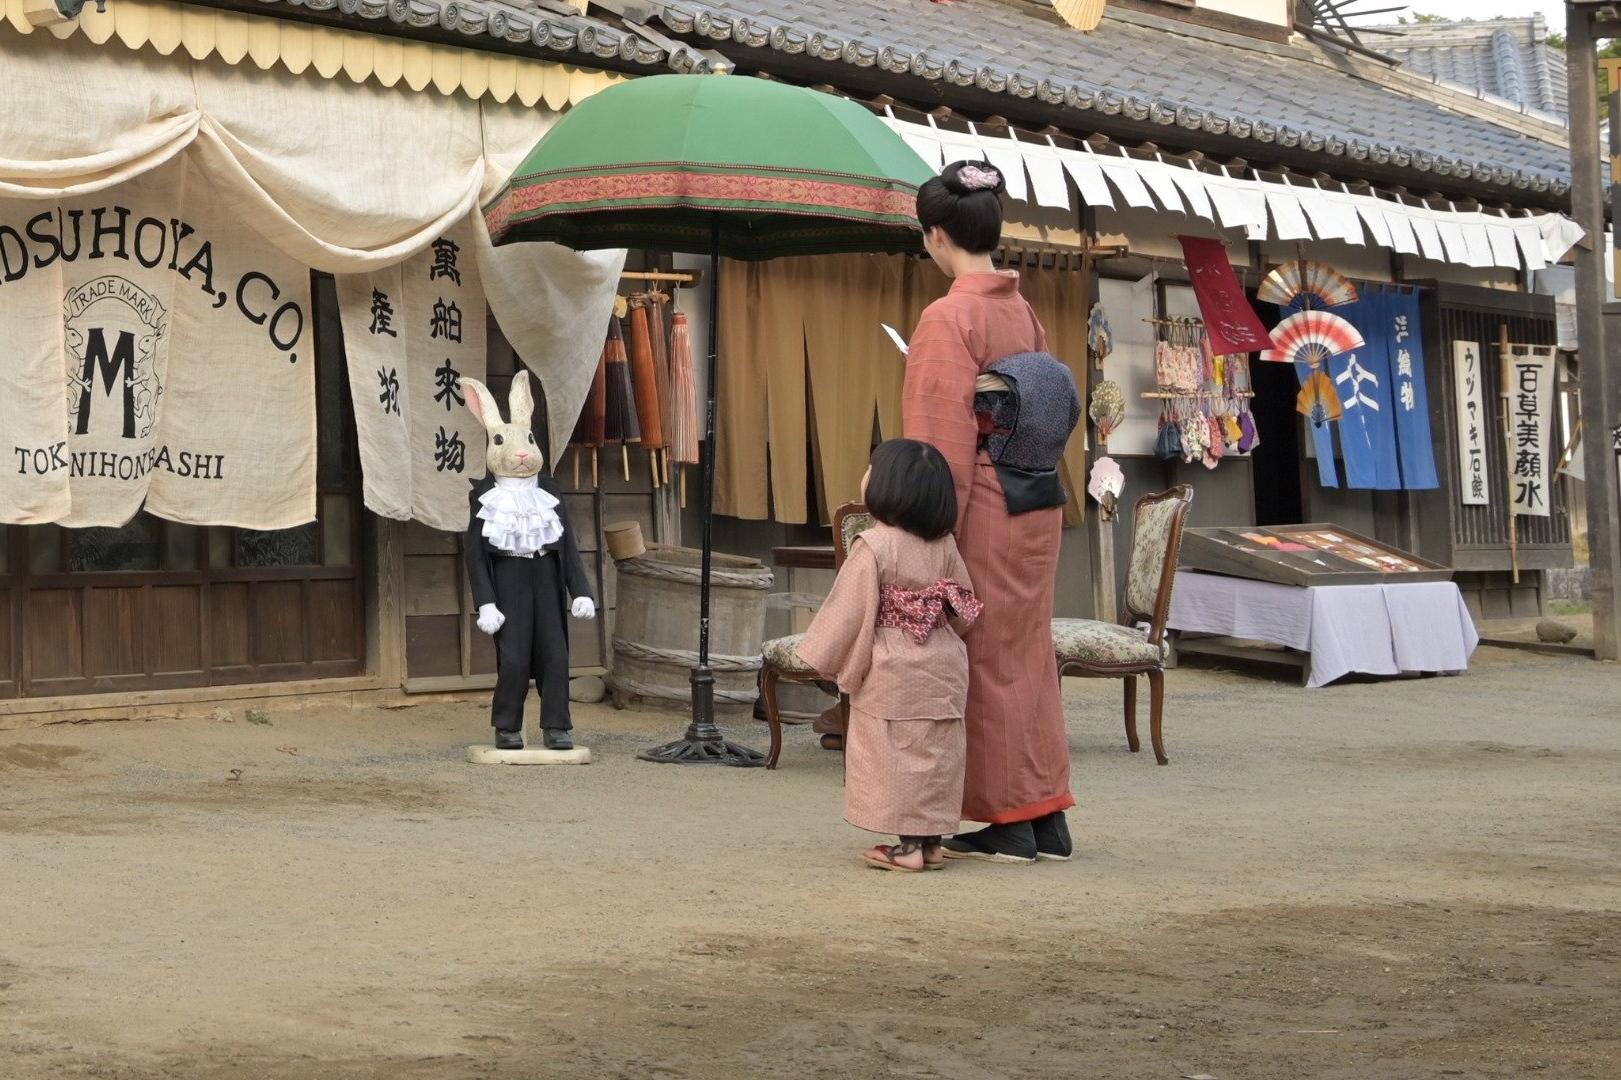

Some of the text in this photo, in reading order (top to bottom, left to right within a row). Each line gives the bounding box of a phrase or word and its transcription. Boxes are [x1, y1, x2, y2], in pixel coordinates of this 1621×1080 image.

[71, 279, 153, 321] TRADE MARK
[74, 326, 136, 440] M
